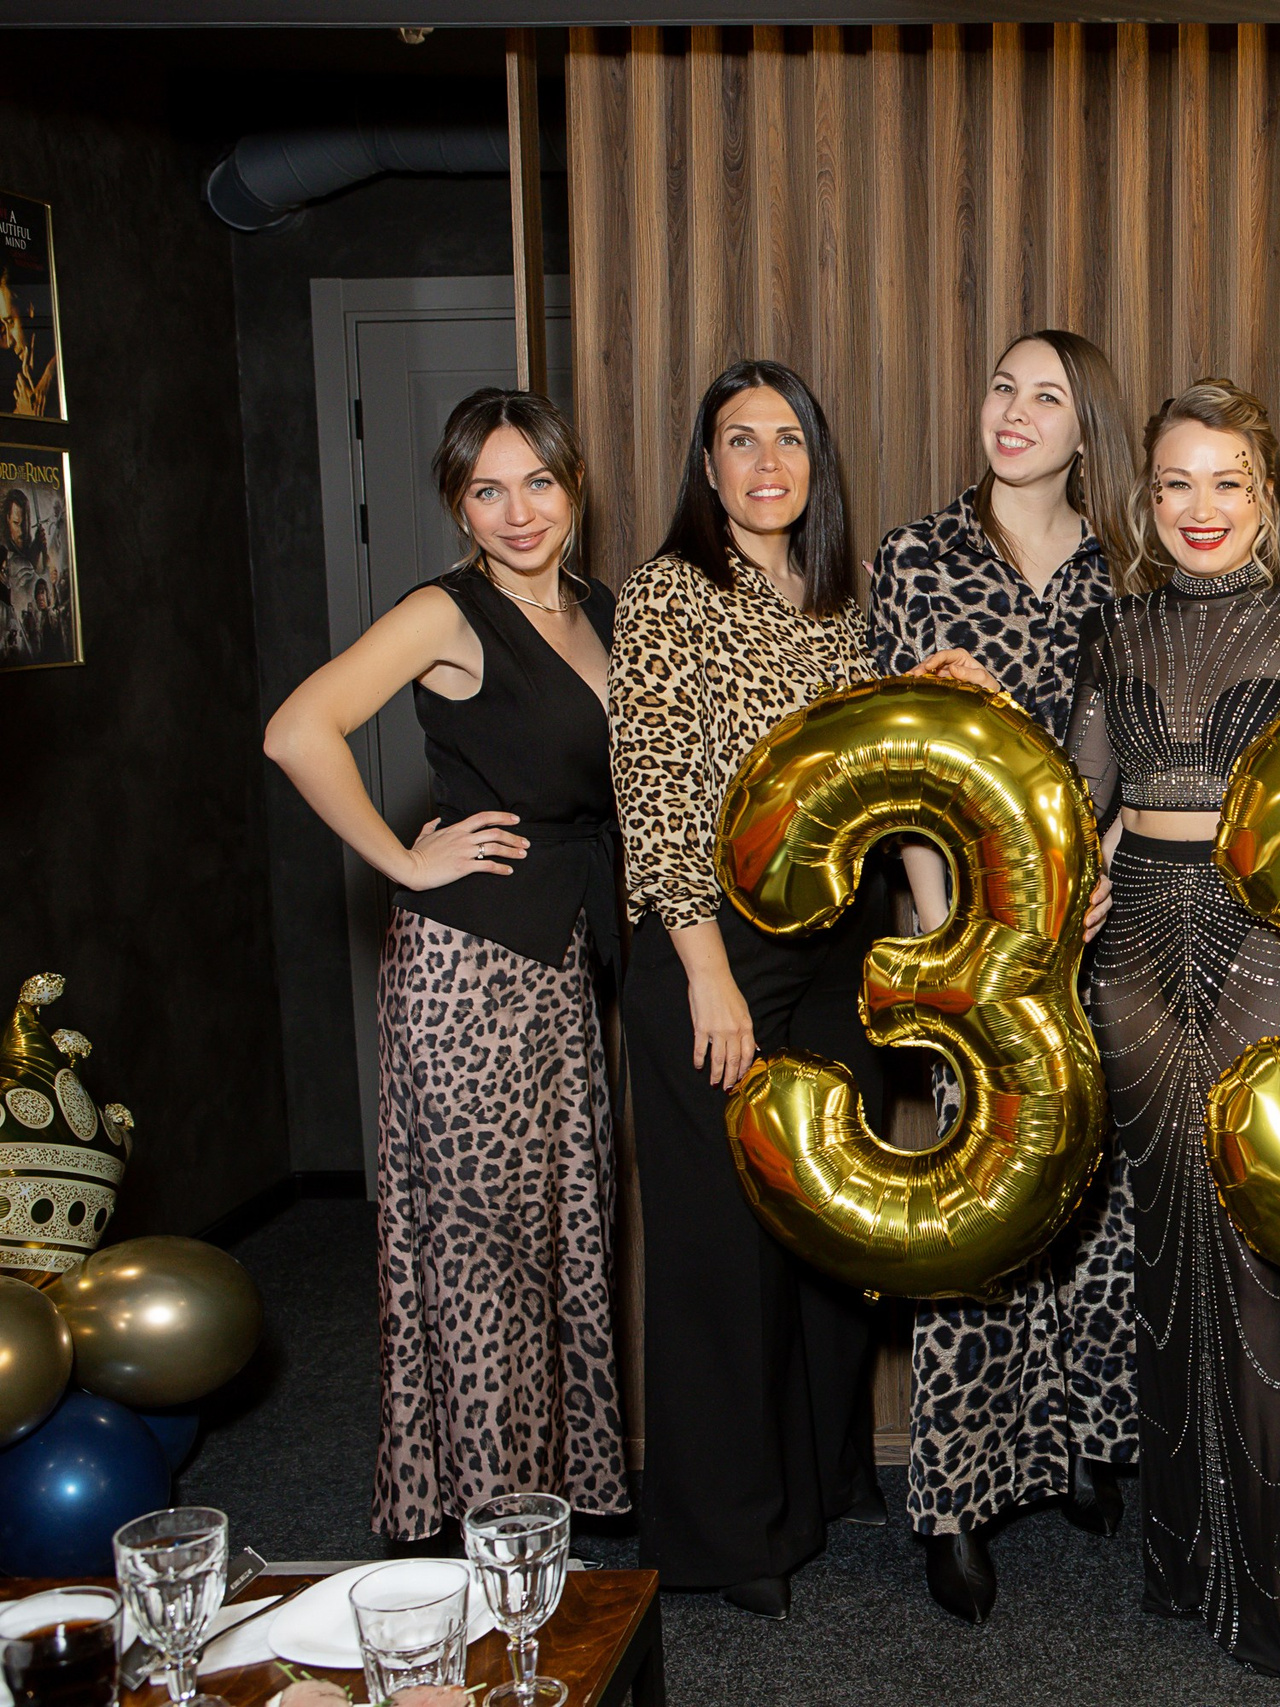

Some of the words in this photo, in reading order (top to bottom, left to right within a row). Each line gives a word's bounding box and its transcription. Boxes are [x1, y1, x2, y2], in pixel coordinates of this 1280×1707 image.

[9, 209, 17, 224] A
[5, 236, 27, 251] MIND
[0, 461, 18, 480] RD
[25, 461, 60, 490] RINGS
